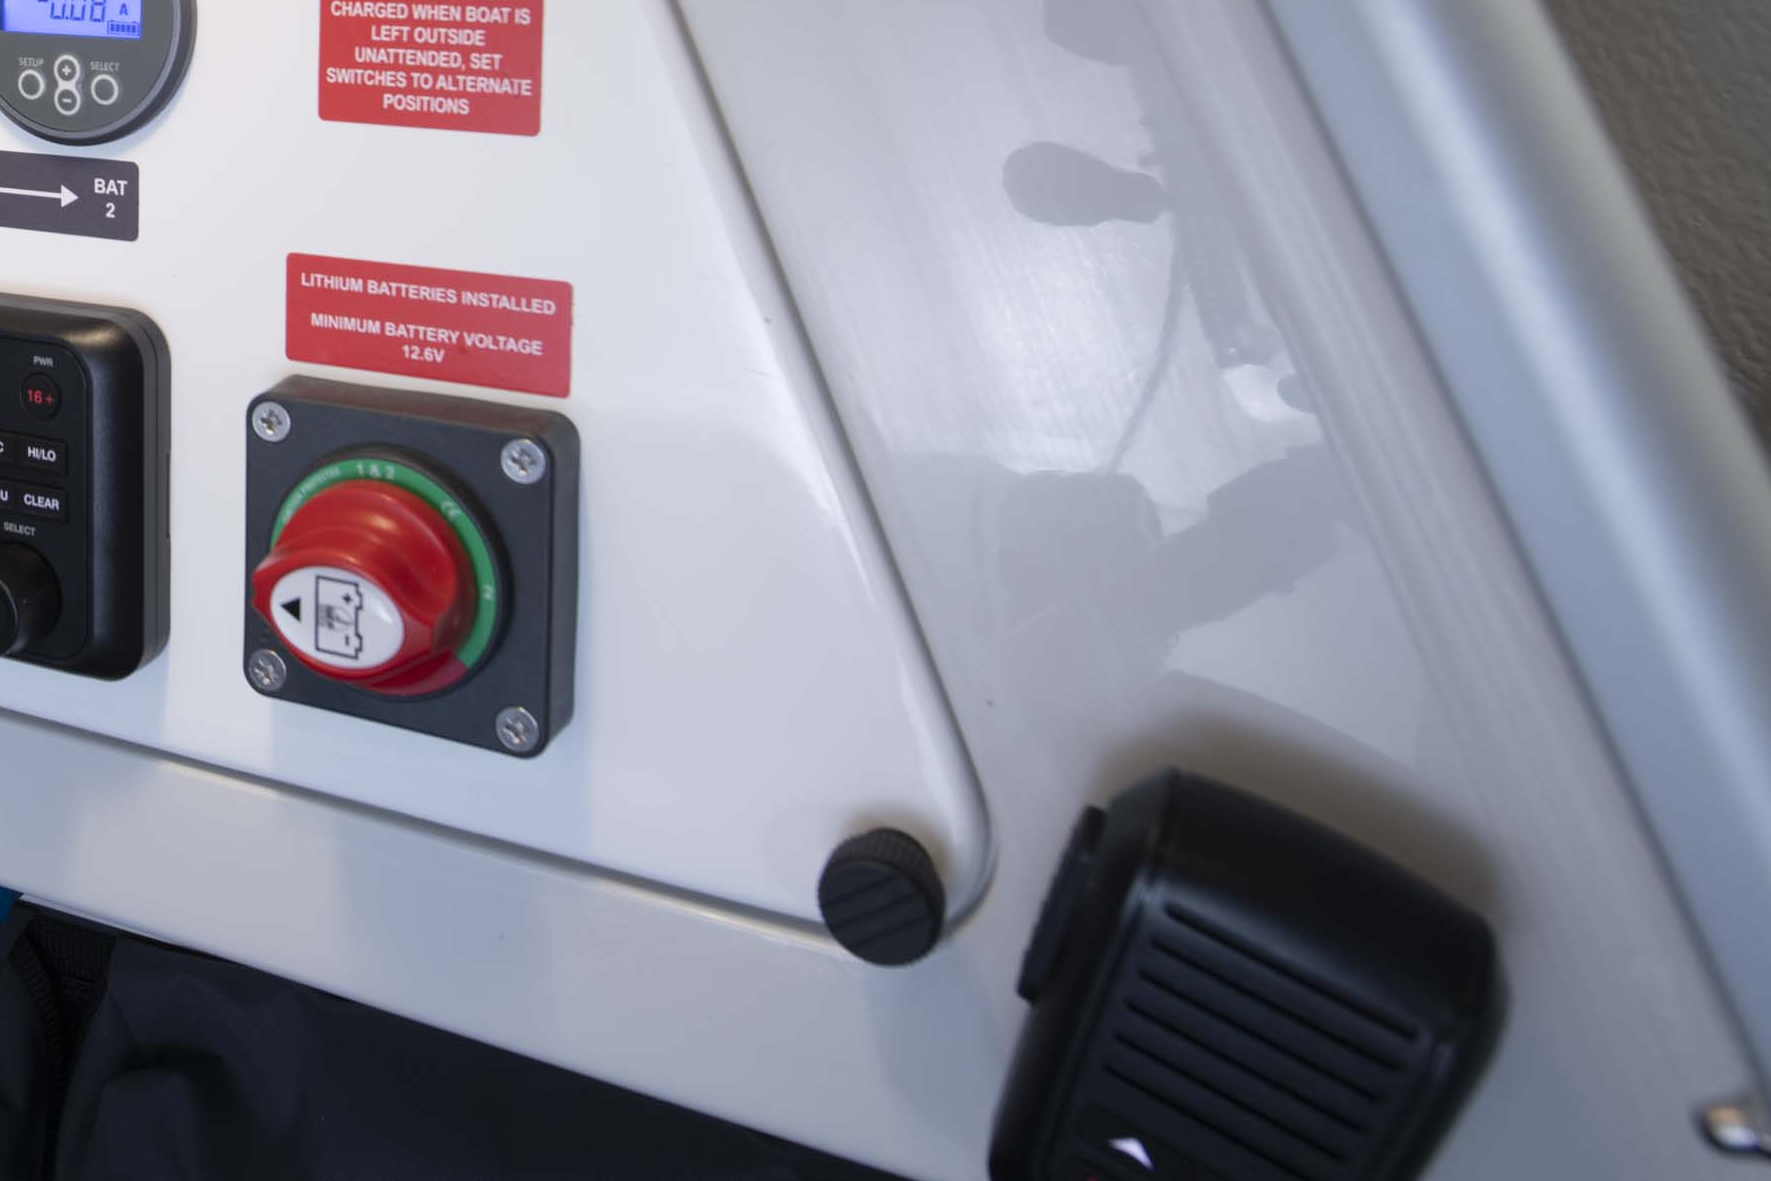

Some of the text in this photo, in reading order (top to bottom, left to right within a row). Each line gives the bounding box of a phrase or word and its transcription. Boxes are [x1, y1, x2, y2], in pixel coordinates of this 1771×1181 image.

[119, 3, 128, 15] A
[331, 1, 531, 24] CHARGED WHEN BOAT IS
[371, 25, 485, 46] LEFT OUTSIDE
[19, 57, 44, 67] SETUP
[90, 61, 119, 72] SELECT
[355, 47, 502, 71] UNATTENDED, SET
[326, 67, 532, 95] SWITCHES TO ALTERNATE
[383, 93, 470, 115] POSITIONS
[94, 178, 128, 196] BAT
[105, 202, 115, 218] 2
[301, 272, 556, 316] LITHIUM BATTERIES INSTALLED
[311, 312, 543, 355] MINIMUM BATTERY VOLTAGE
[33, 355, 53, 367] PWR
[402, 344, 445, 363] 12.6V
[27, 446, 56, 462] HI/LO
[356, 463, 365, 476] 1
[385, 467, 395, 480] 2
[23, 493, 60, 511] CLEAR
[4, 521, 36, 537] SELECT
